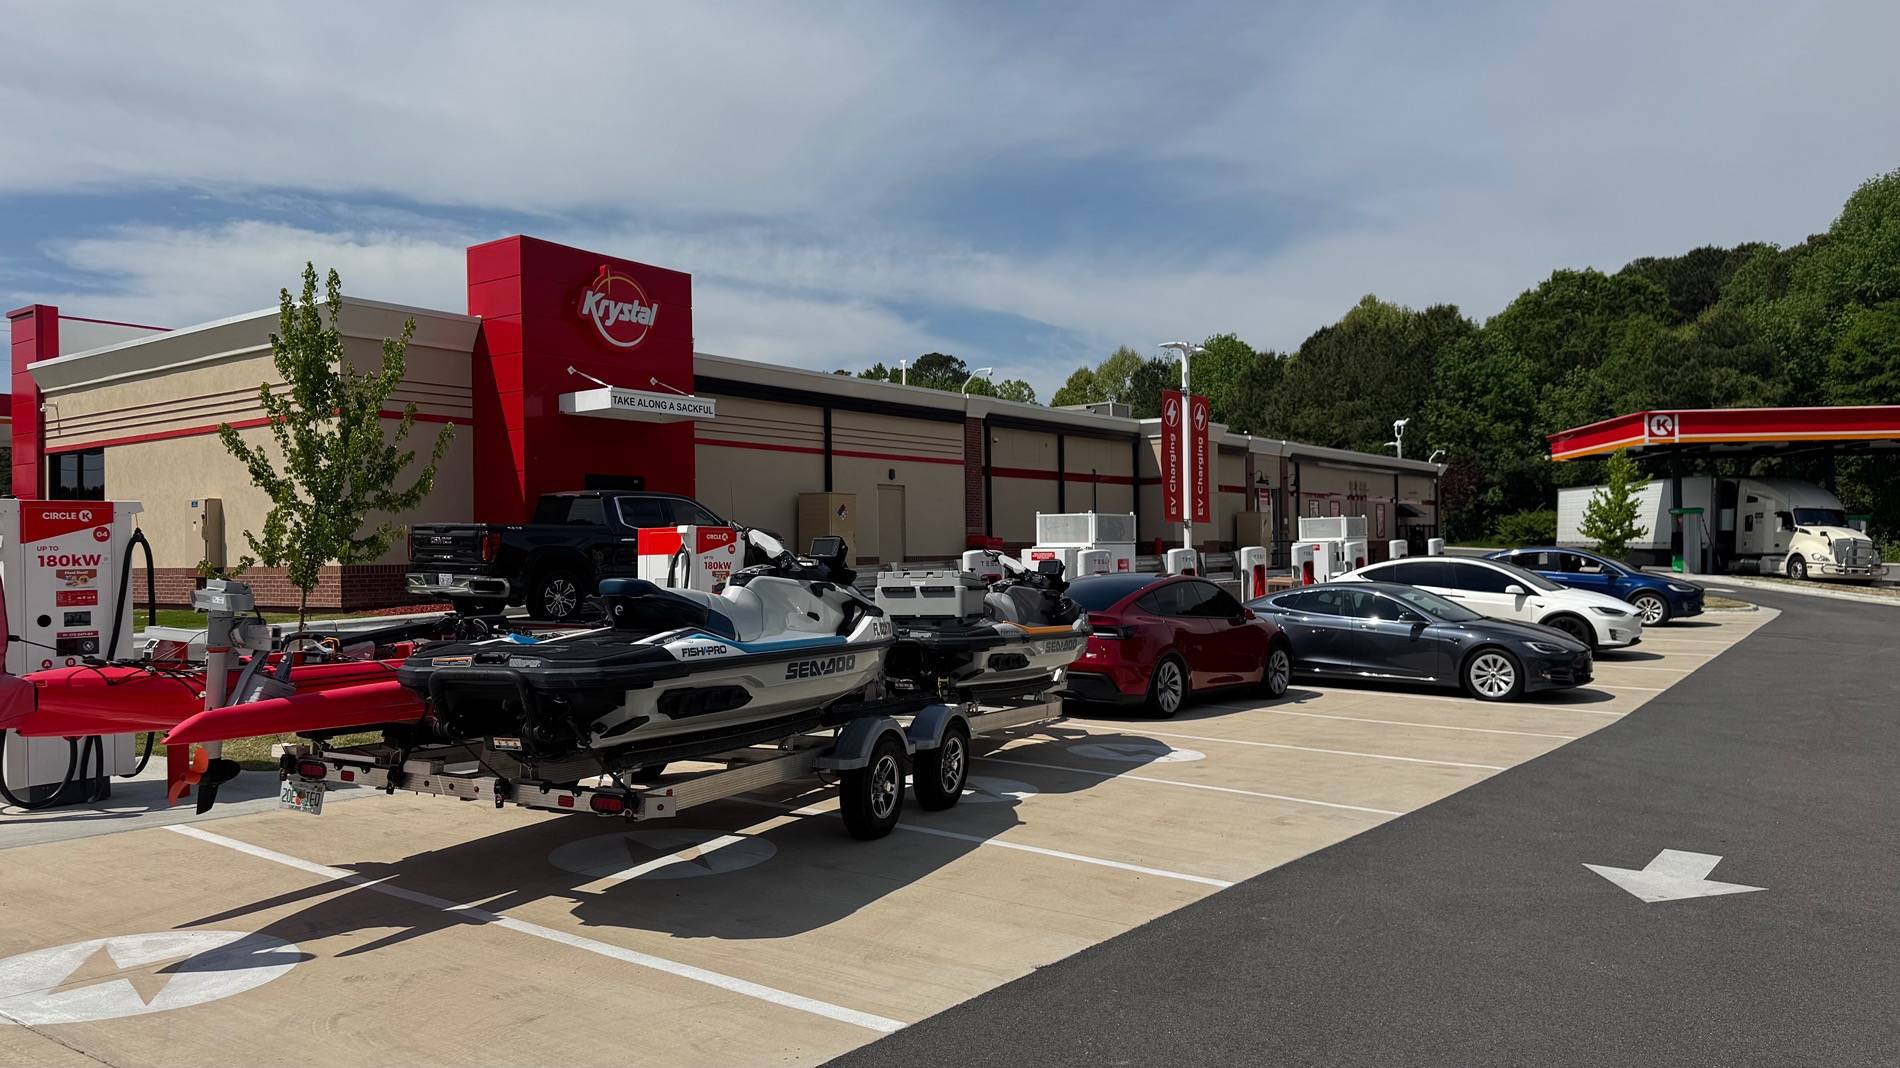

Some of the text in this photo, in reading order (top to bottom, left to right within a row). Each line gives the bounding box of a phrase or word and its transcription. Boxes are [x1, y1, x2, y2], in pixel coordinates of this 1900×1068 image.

[582, 290, 659, 327] Krystal
[613, 395, 713, 415] TAKE ALONG A SACKFUL
[1169, 433, 1177, 515] EV Charging
[42, 512, 77, 520] CIRCLE
[1197, 498, 1204, 516] EV
[38, 554, 101, 567] 180kW
[703, 561, 732, 570] 180kW
